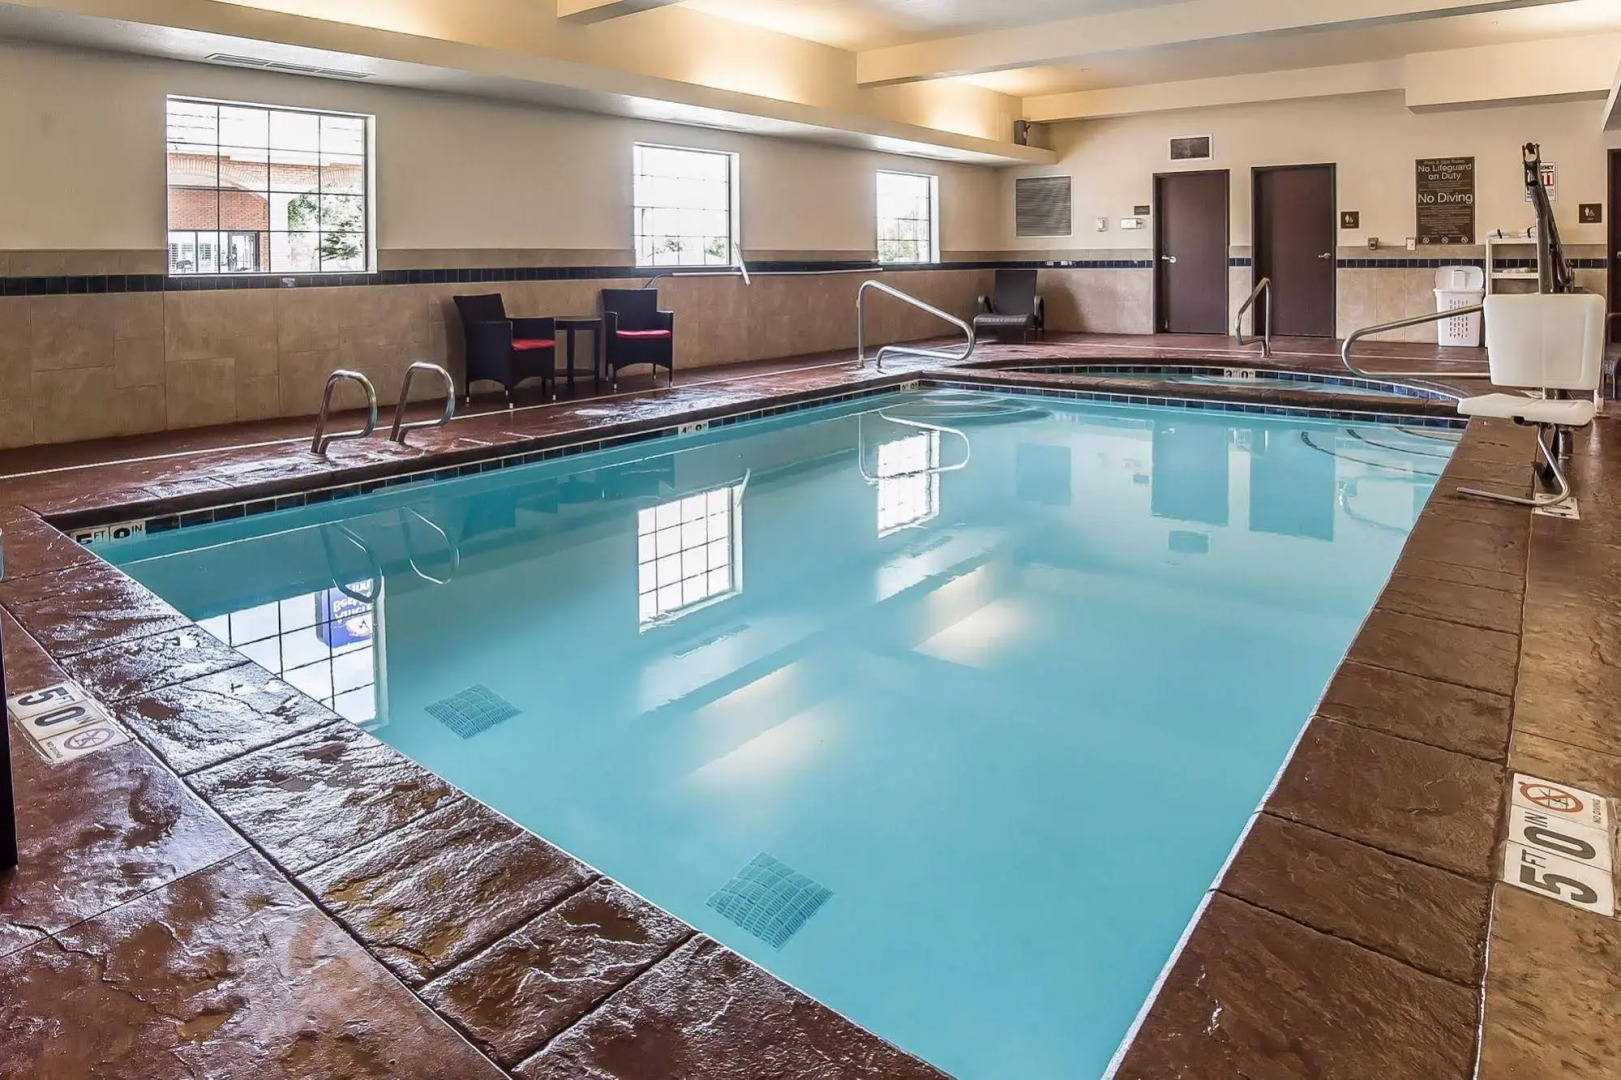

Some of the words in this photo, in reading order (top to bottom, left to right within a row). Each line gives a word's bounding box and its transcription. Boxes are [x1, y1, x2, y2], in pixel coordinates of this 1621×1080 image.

[1432, 163, 1472, 173] Lifeguard
[1441, 172, 1461, 180] Duty
[1418, 193, 1435, 204] No
[1437, 192, 1473, 204] Diving
[113, 527, 131, 539] 0
[131, 524, 143, 532] IN
[17, 686, 69, 706] 5
[34, 706, 86, 727] 0
[1524, 811, 1548, 828] IN
[1523, 826, 1597, 860] 0
[1521, 849, 1546, 869] FT
[1520, 864, 1598, 904] 5
